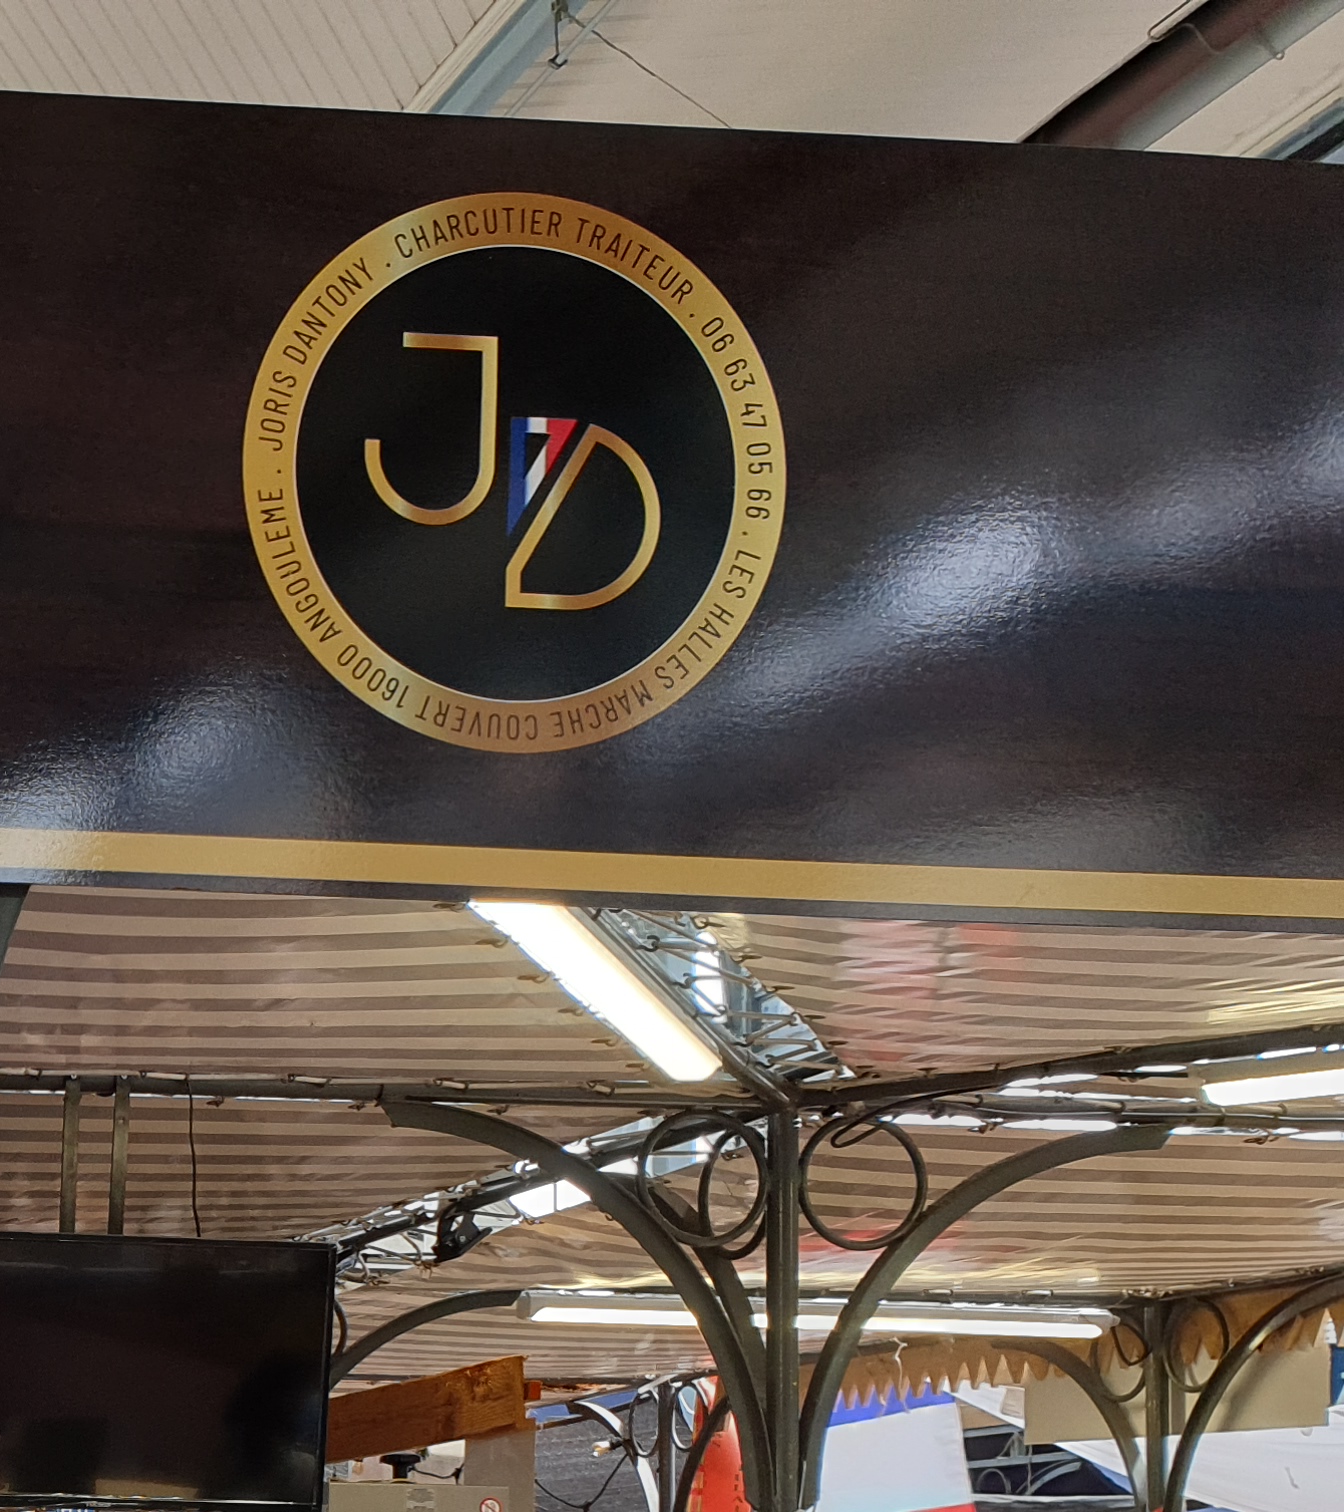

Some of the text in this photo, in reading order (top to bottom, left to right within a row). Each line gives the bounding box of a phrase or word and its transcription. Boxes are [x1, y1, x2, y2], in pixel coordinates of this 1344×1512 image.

[257, 256, 375, 452] JORIS DANTONY
[394, 206, 696, 306] CHARCUTIER TRAITEUR
[700, 314, 774, 522] 06 63 47 05 66
[257, 486, 765, 741] LES HALLES MARCHE COUVERT 16000 ANGOULEME
